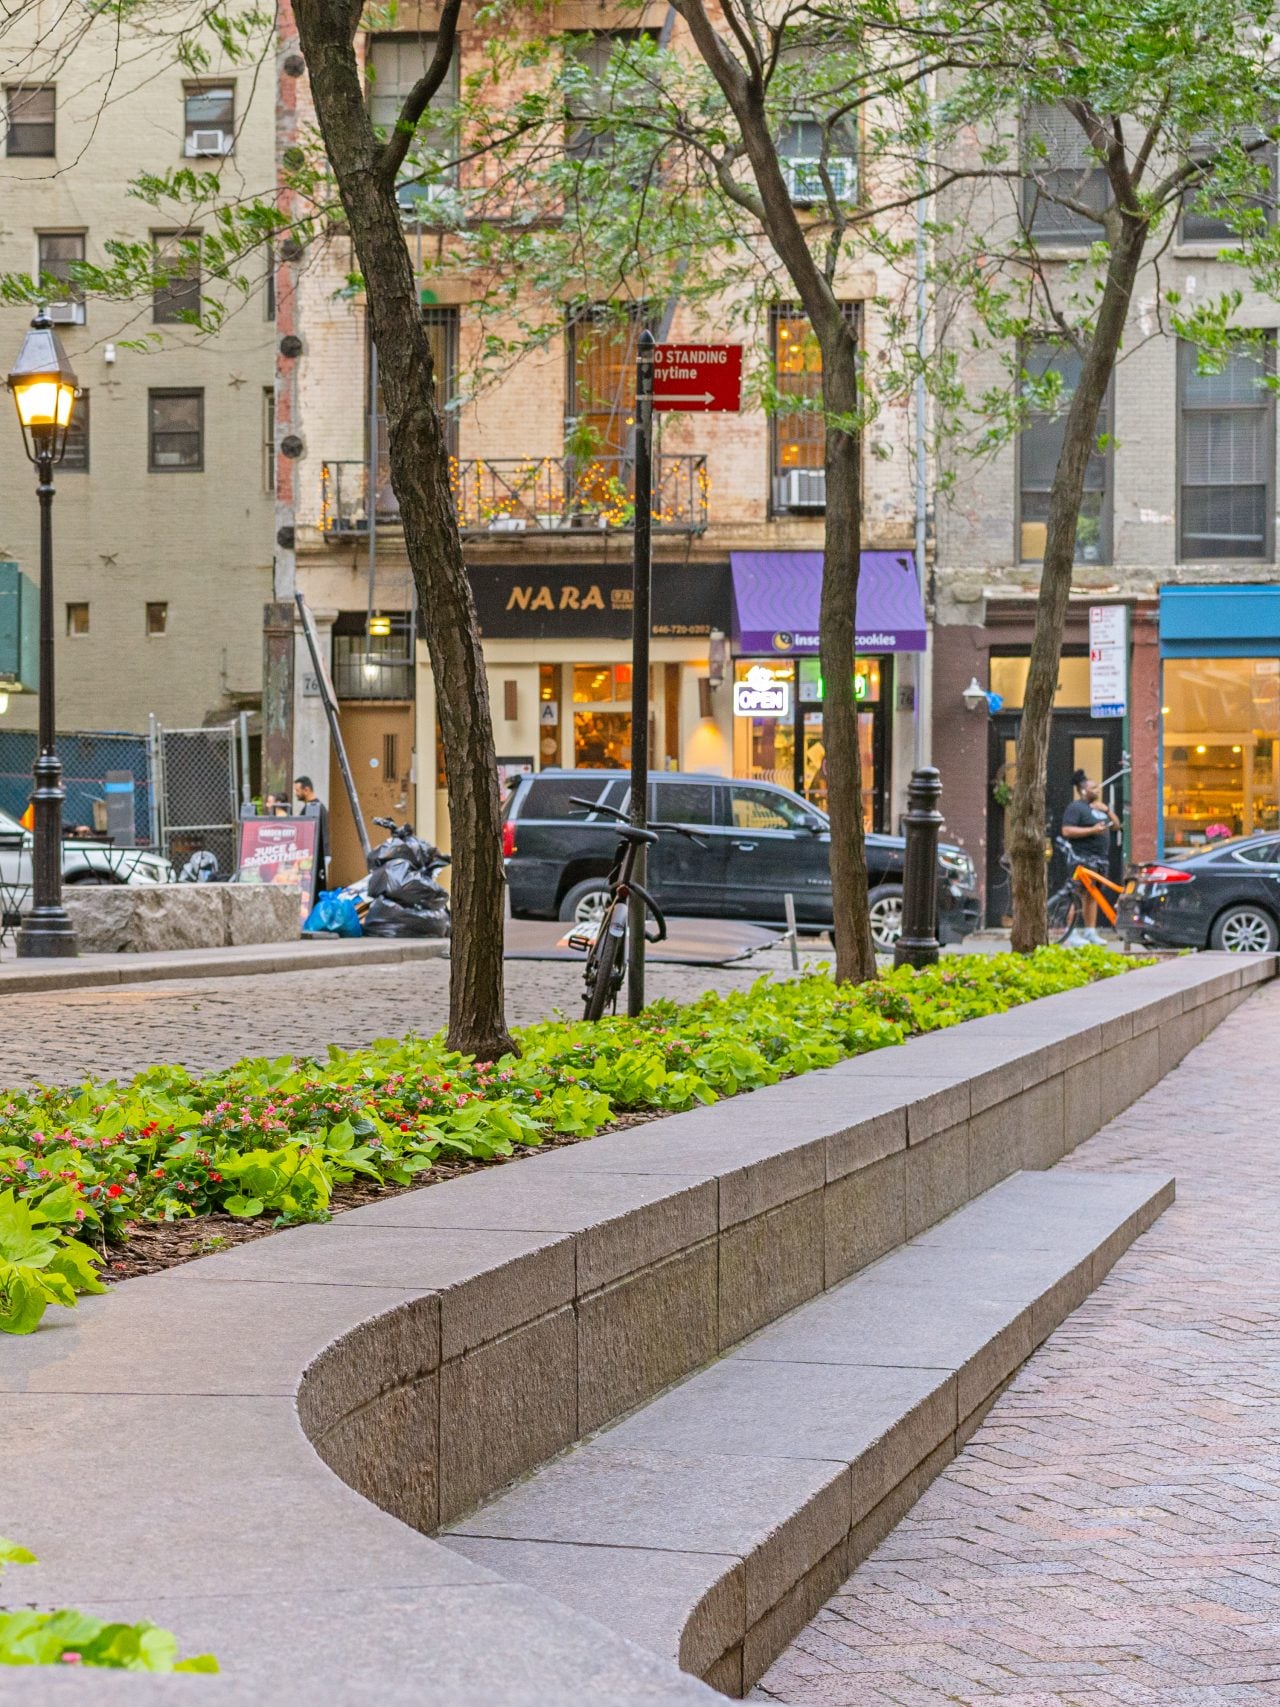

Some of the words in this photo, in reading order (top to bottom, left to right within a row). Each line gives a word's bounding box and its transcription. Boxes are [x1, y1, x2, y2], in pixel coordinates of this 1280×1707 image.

[654, 350, 663, 363] O
[666, 350, 728, 364] STANDING
[654, 365, 698, 382] nytime
[505, 585, 606, 611] NARA
[855, 633, 896, 646] cookies
[304, 677, 319, 690] 76
[739, 690, 783, 709] OPEN
[542, 705, 554, 718] A
[244, 849, 309, 867] SMOOTHIES
[254, 845, 287, 858] JUICE
[287, 843, 297, 852] &
